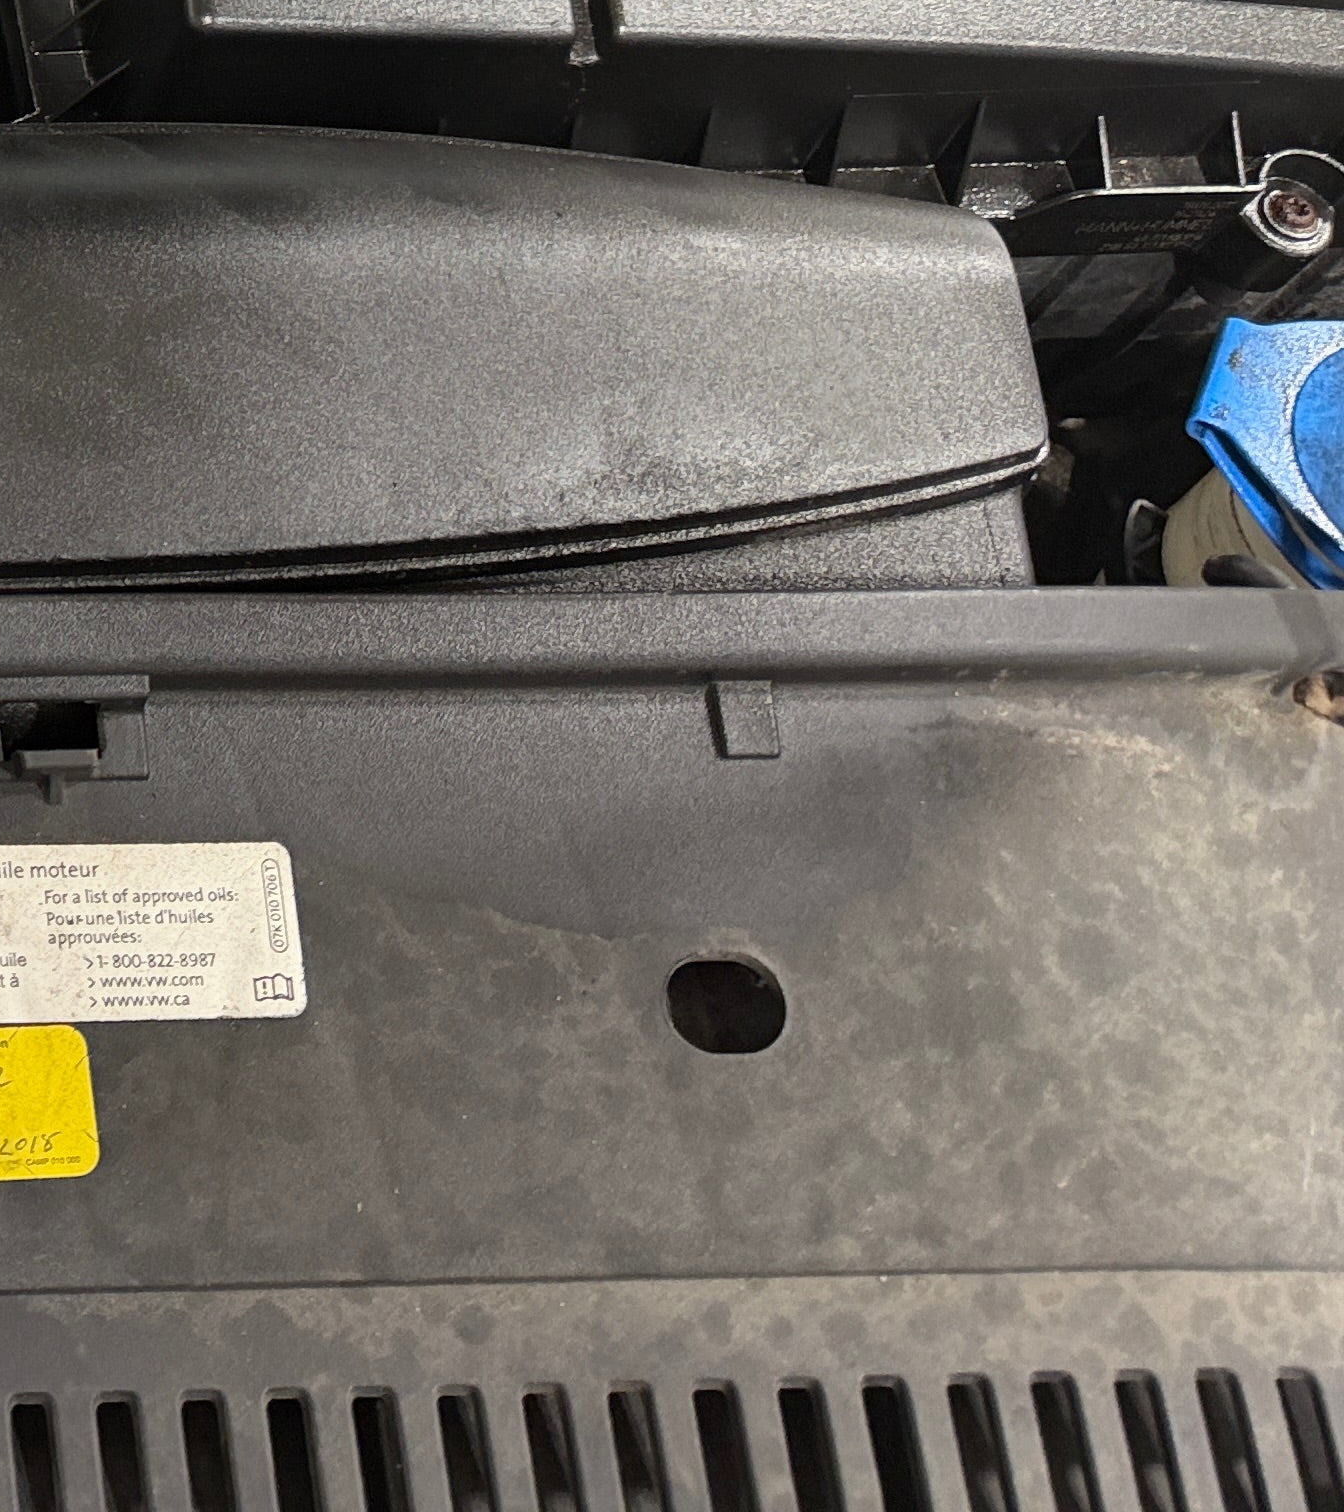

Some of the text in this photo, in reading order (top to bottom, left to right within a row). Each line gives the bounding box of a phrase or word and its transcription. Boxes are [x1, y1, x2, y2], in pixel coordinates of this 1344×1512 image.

[30, 862, 99, 878] moteur
[44, 890, 67, 905] For
[72, 892, 80, 904] a
[85, 889, 109, 904] list
[112, 889, 128, 903] of
[132, 888, 203, 907] approved
[86, 914, 113, 925] une
[117, 911, 150, 925] liste
[154, 909, 214, 925] d'huiles
[100, 974, 203, 987] www.vw.com
[102, 994, 190, 1007] www.vw.ca
